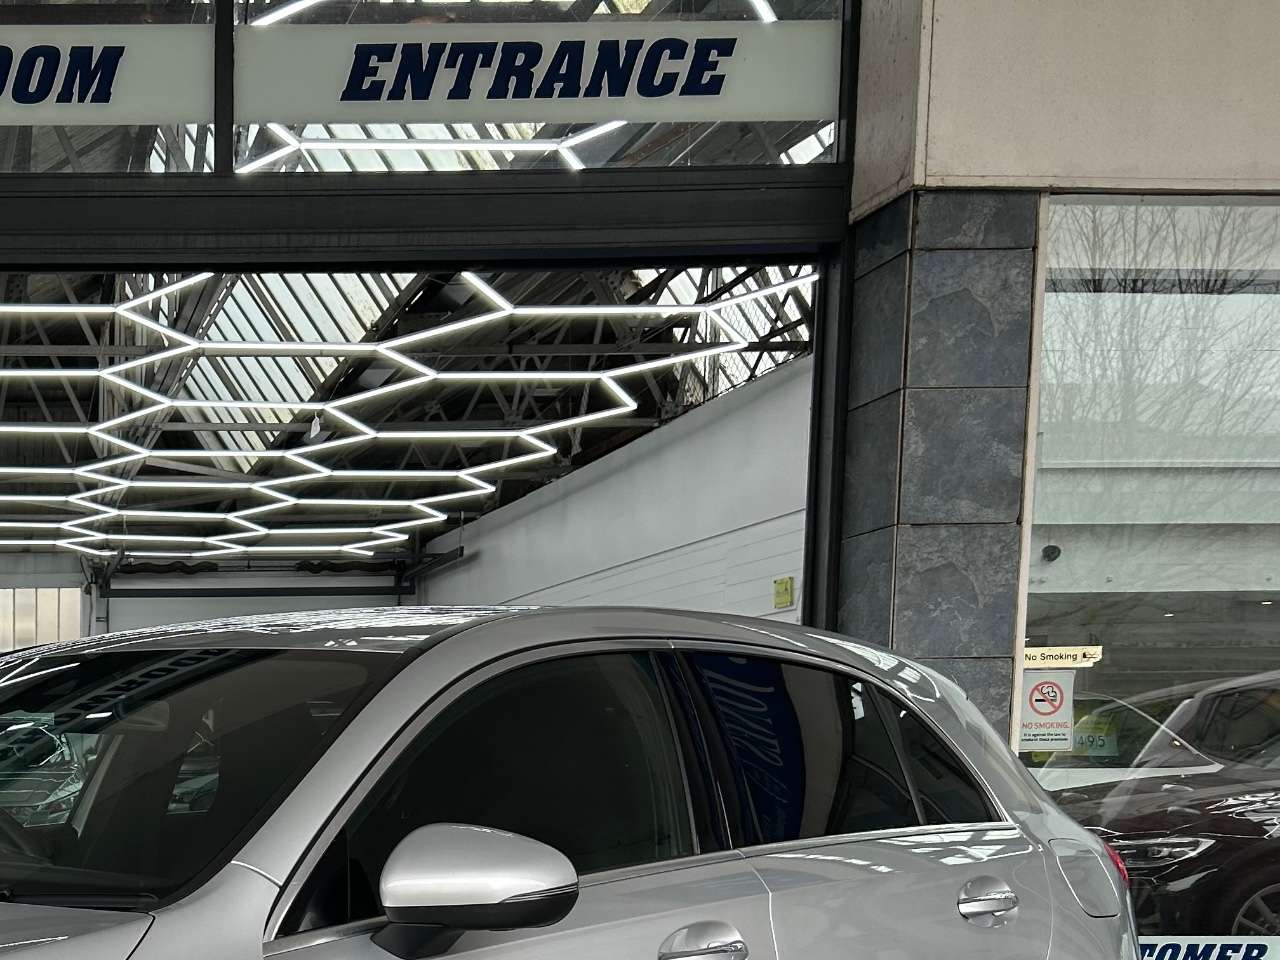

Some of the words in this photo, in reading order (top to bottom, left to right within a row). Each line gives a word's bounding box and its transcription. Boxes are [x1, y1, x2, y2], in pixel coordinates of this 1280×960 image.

[340, 37, 738, 102] ENTRANCE
[1024, 653, 1037, 661] No
[1040, 652, 1078, 661] Smoking
